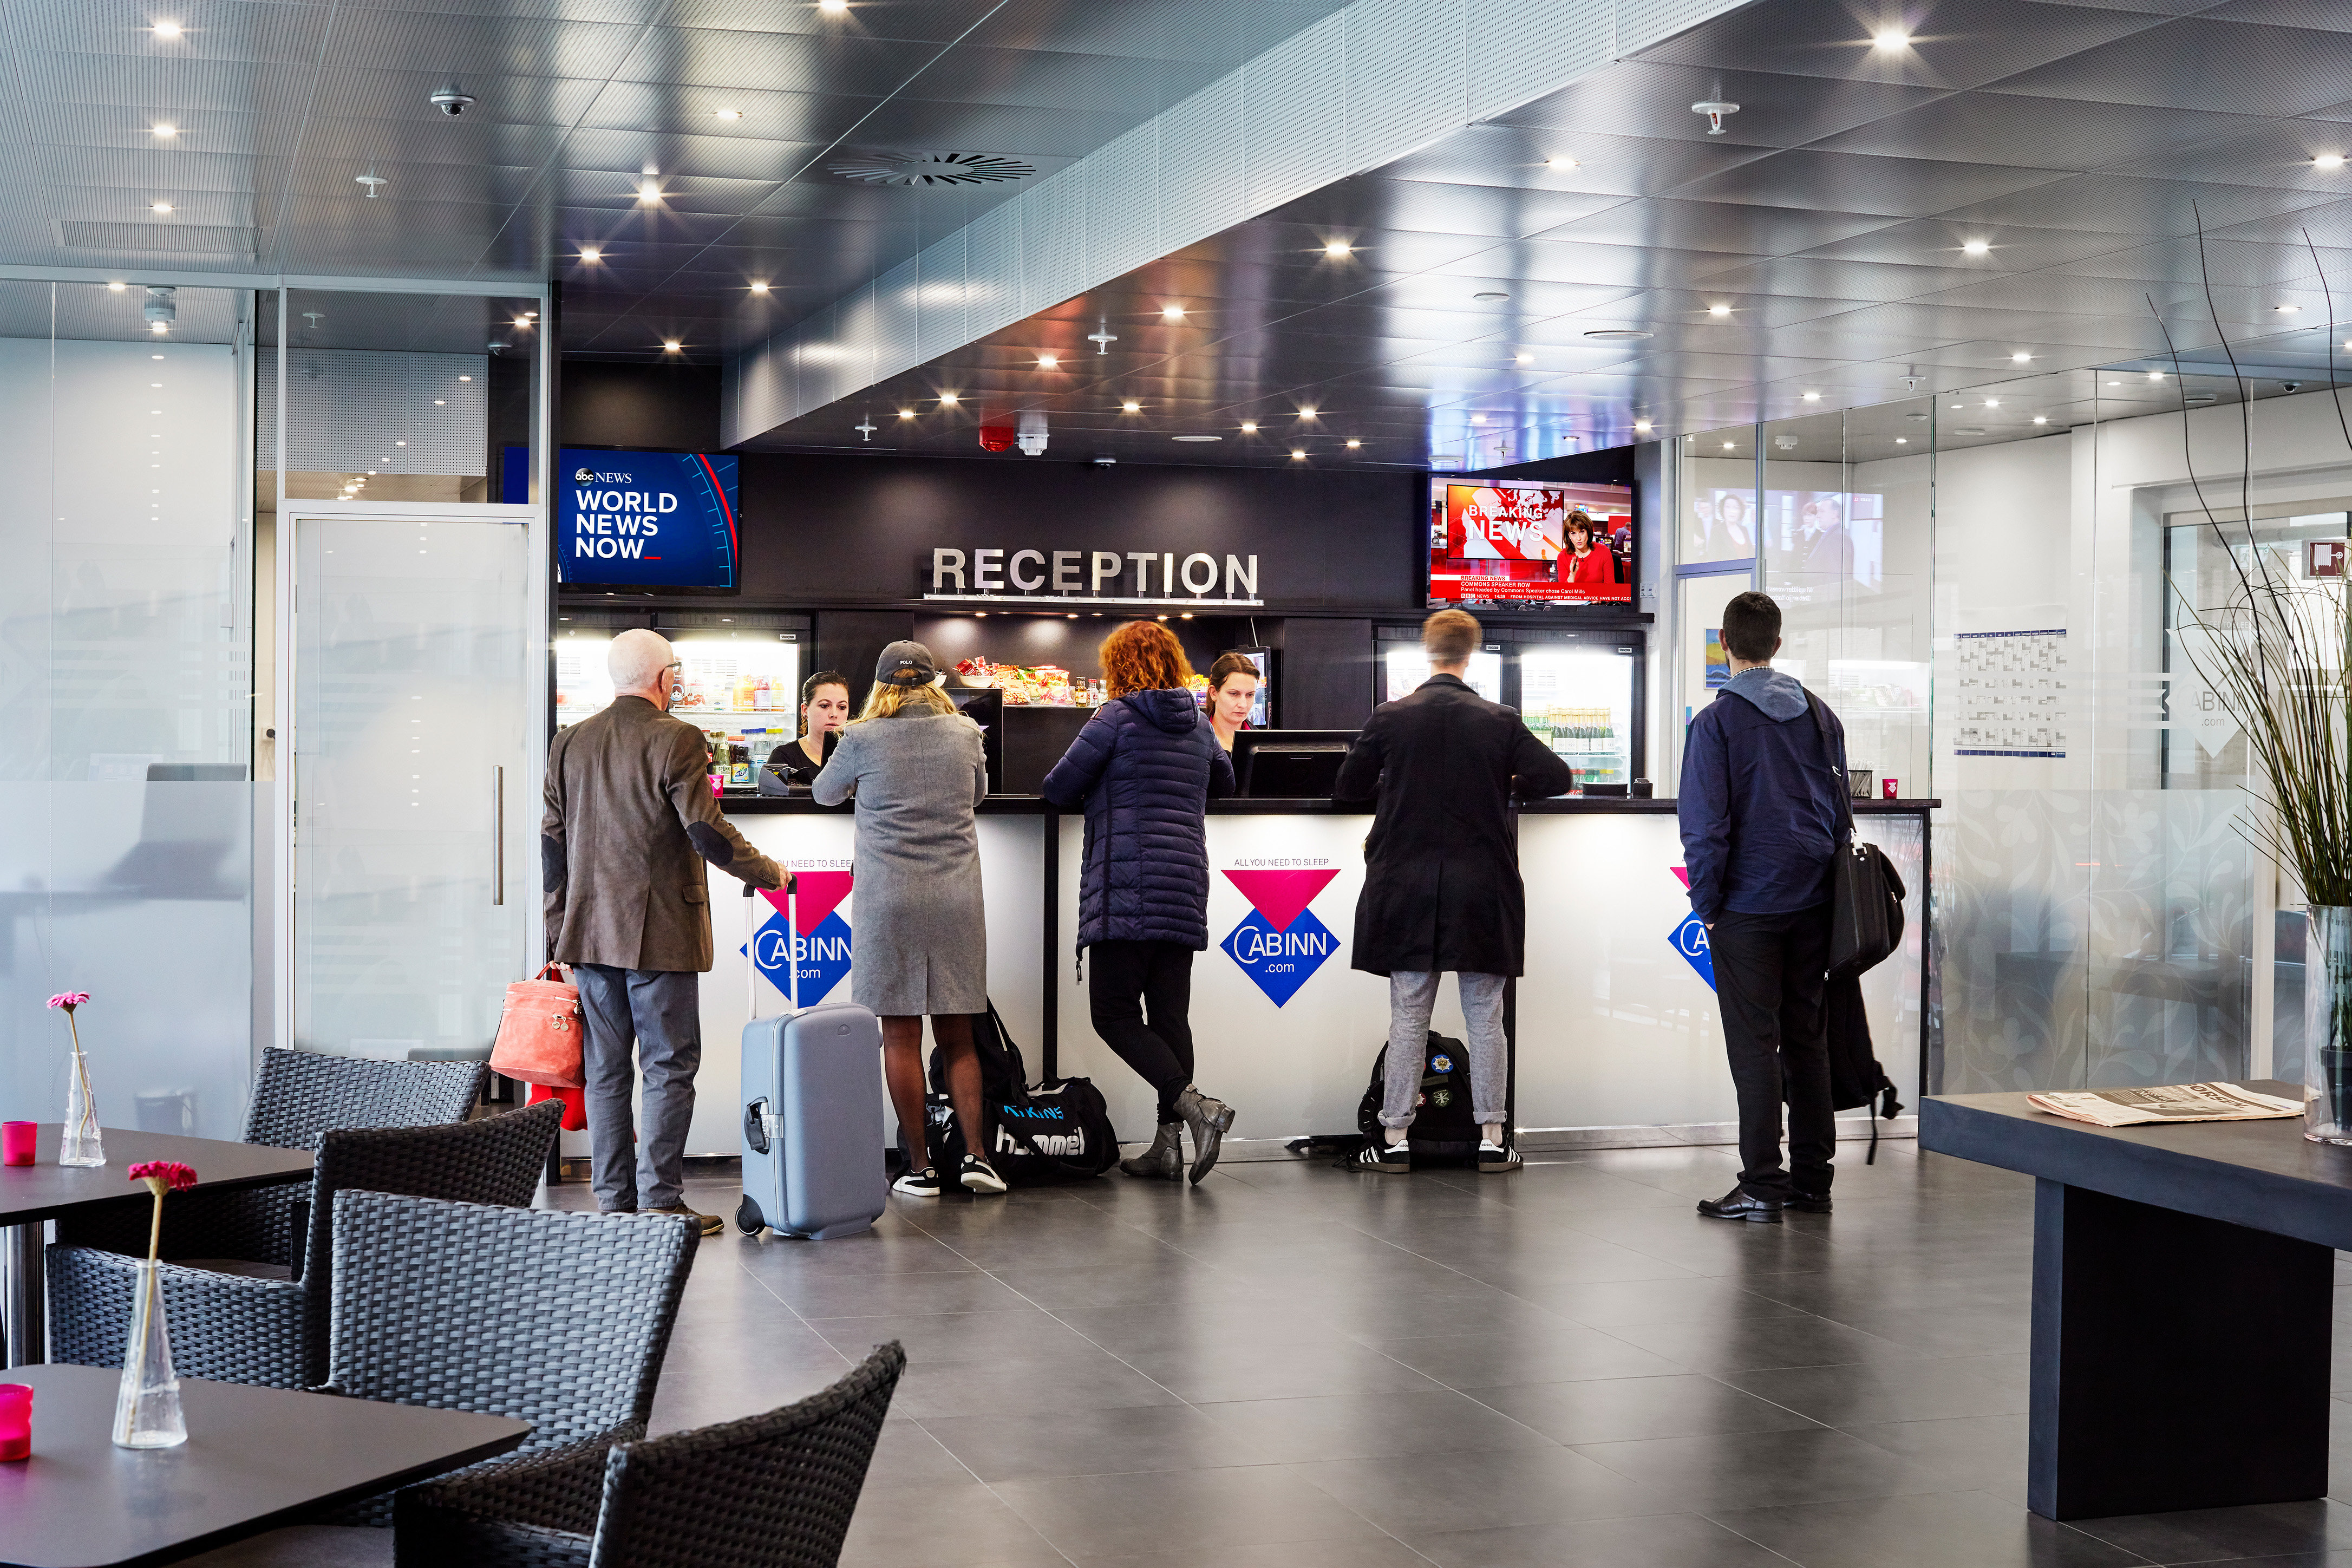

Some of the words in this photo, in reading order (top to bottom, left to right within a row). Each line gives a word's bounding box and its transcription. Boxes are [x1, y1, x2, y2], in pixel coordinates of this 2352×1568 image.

[575, 473, 594, 481] abc
[595, 472, 632, 484] NEWS
[576, 490, 678, 513] WORLD
[1469, 505, 1543, 519] BREAKING
[576, 514, 658, 536] NEWS
[1469, 519, 1544, 541] NEWS
[576, 537, 644, 559] NOW
[933, 547, 1257, 594] RECEPTION
[2201, 718, 2225, 726] .com
[1234, 925, 1327, 964] CABINN
[1265, 963, 1295, 973] .com
[2187, 1083, 2249, 1108] ØRSEN.
[996, 1123, 1085, 1155] hummel
